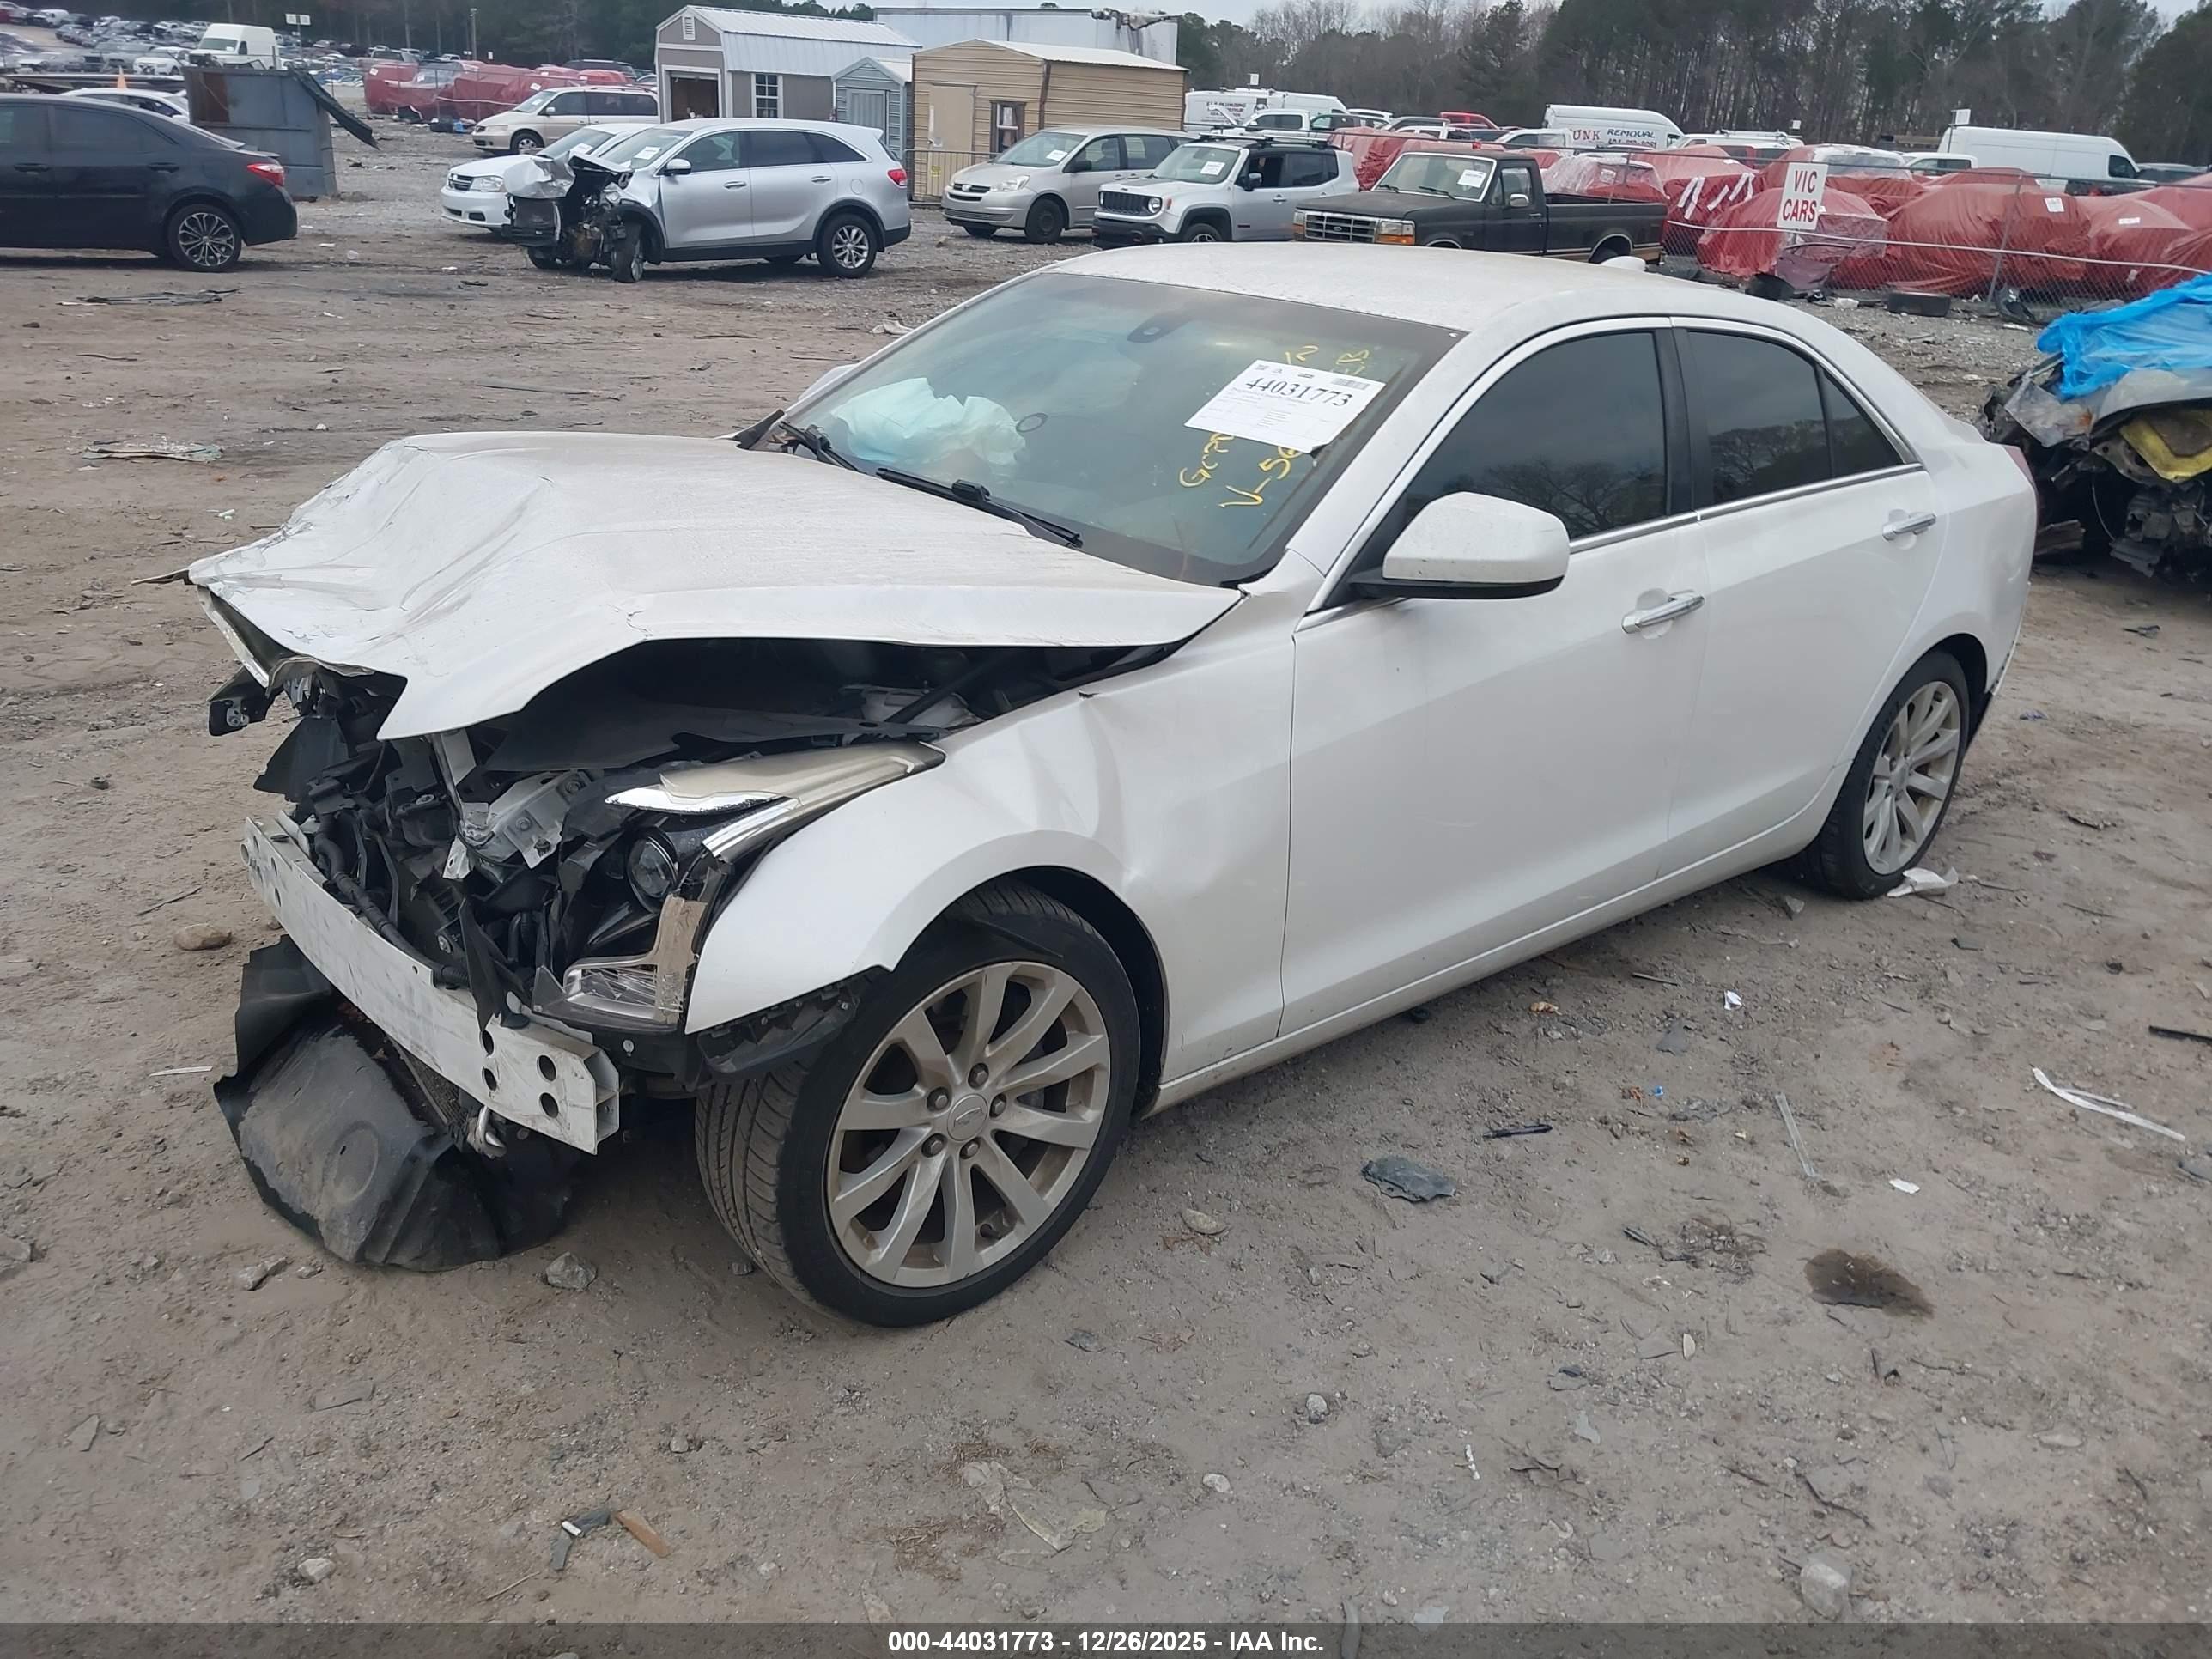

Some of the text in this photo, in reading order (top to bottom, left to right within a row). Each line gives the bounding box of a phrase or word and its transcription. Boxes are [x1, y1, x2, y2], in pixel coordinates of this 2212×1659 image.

[1795, 171, 1817, 192] VIC
[1783, 199, 1817, 222] CARS
[1245, 377, 1353, 406] 44031773
